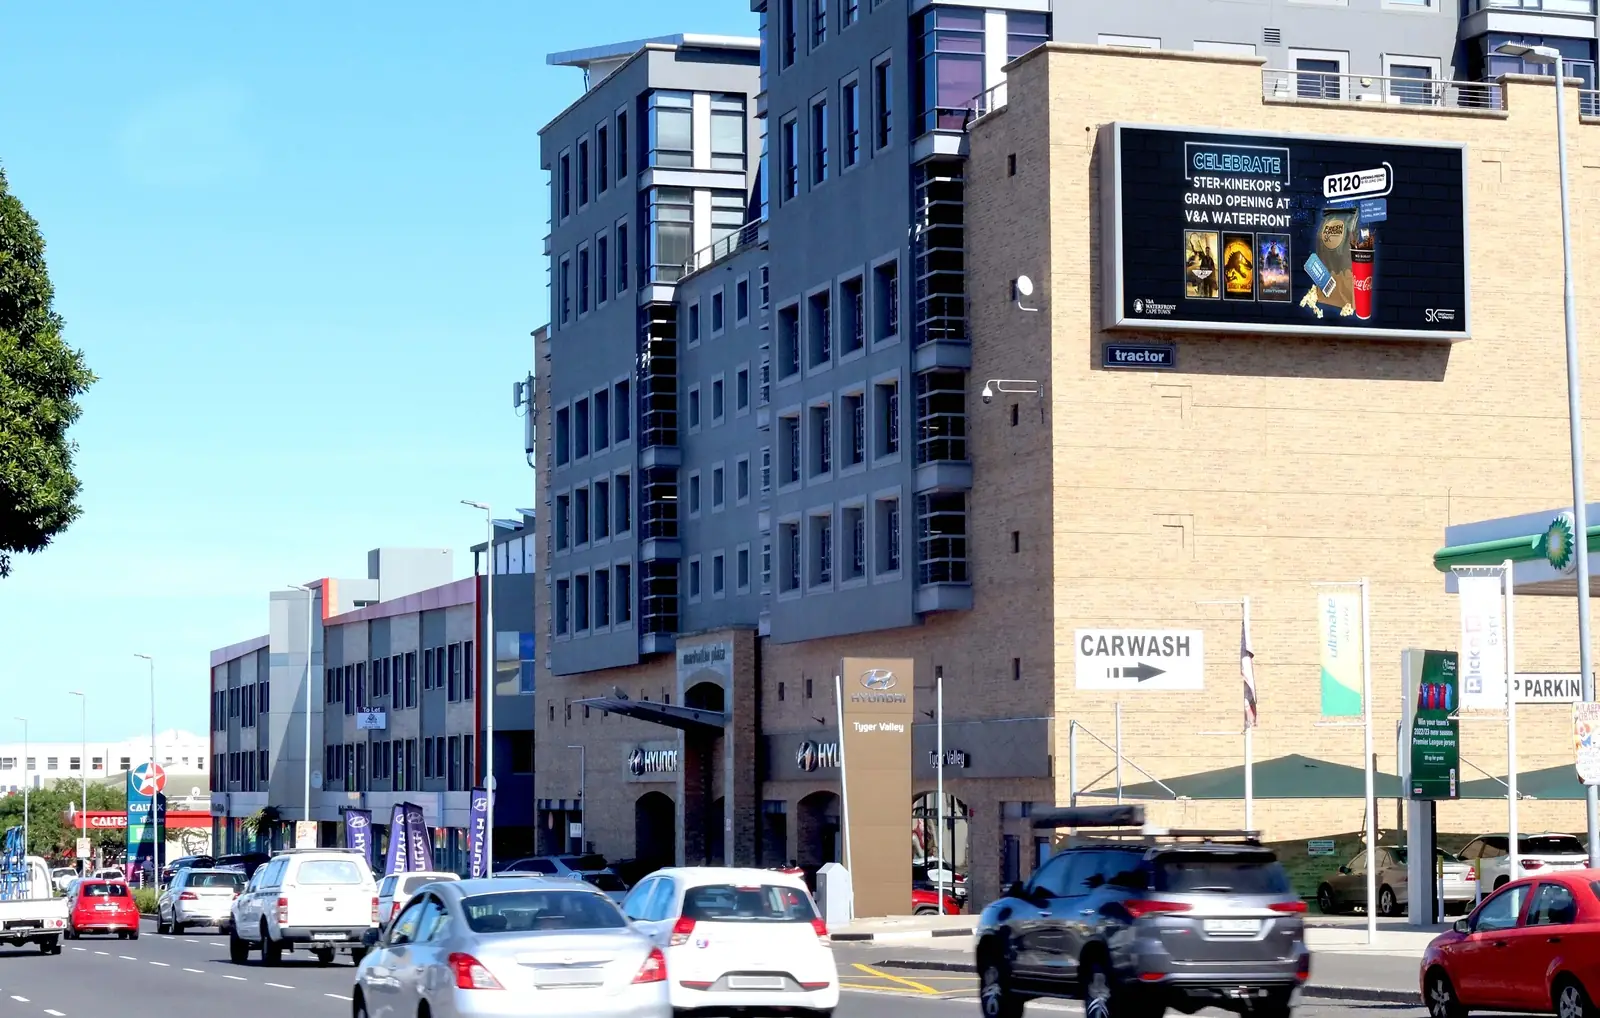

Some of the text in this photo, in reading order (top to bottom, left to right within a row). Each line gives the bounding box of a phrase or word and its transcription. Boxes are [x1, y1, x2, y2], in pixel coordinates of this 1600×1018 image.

[1193, 152, 1281, 174] CELEBRATE
[1193, 176, 1281, 192] STER-KINEKOR'S
[1327, 174, 1361, 194] R120
[1184, 192, 1291, 210] GRAND OPENING AT
[1185, 209, 1291, 228] V&A WATERFRONT
[1324, 223, 1344, 233] FRESH
[1115, 349, 1165, 362] tractor
[1327, 597, 1338, 659] ultimate
[1080, 634, 1190, 657] CARWASH
[851, 692, 907, 704] HYUNDAI
[1524, 679, 1581, 697] PARKIN
[854, 721, 905, 733] Tyger Valley
[644, 750, 678, 772] HYUNDA
[929, 749, 965, 769] Tygr Valley
[394, 830, 406, 873] HYUN
[412, 829, 426, 872] HYUN
[471, 817, 485, 878] HYUND
